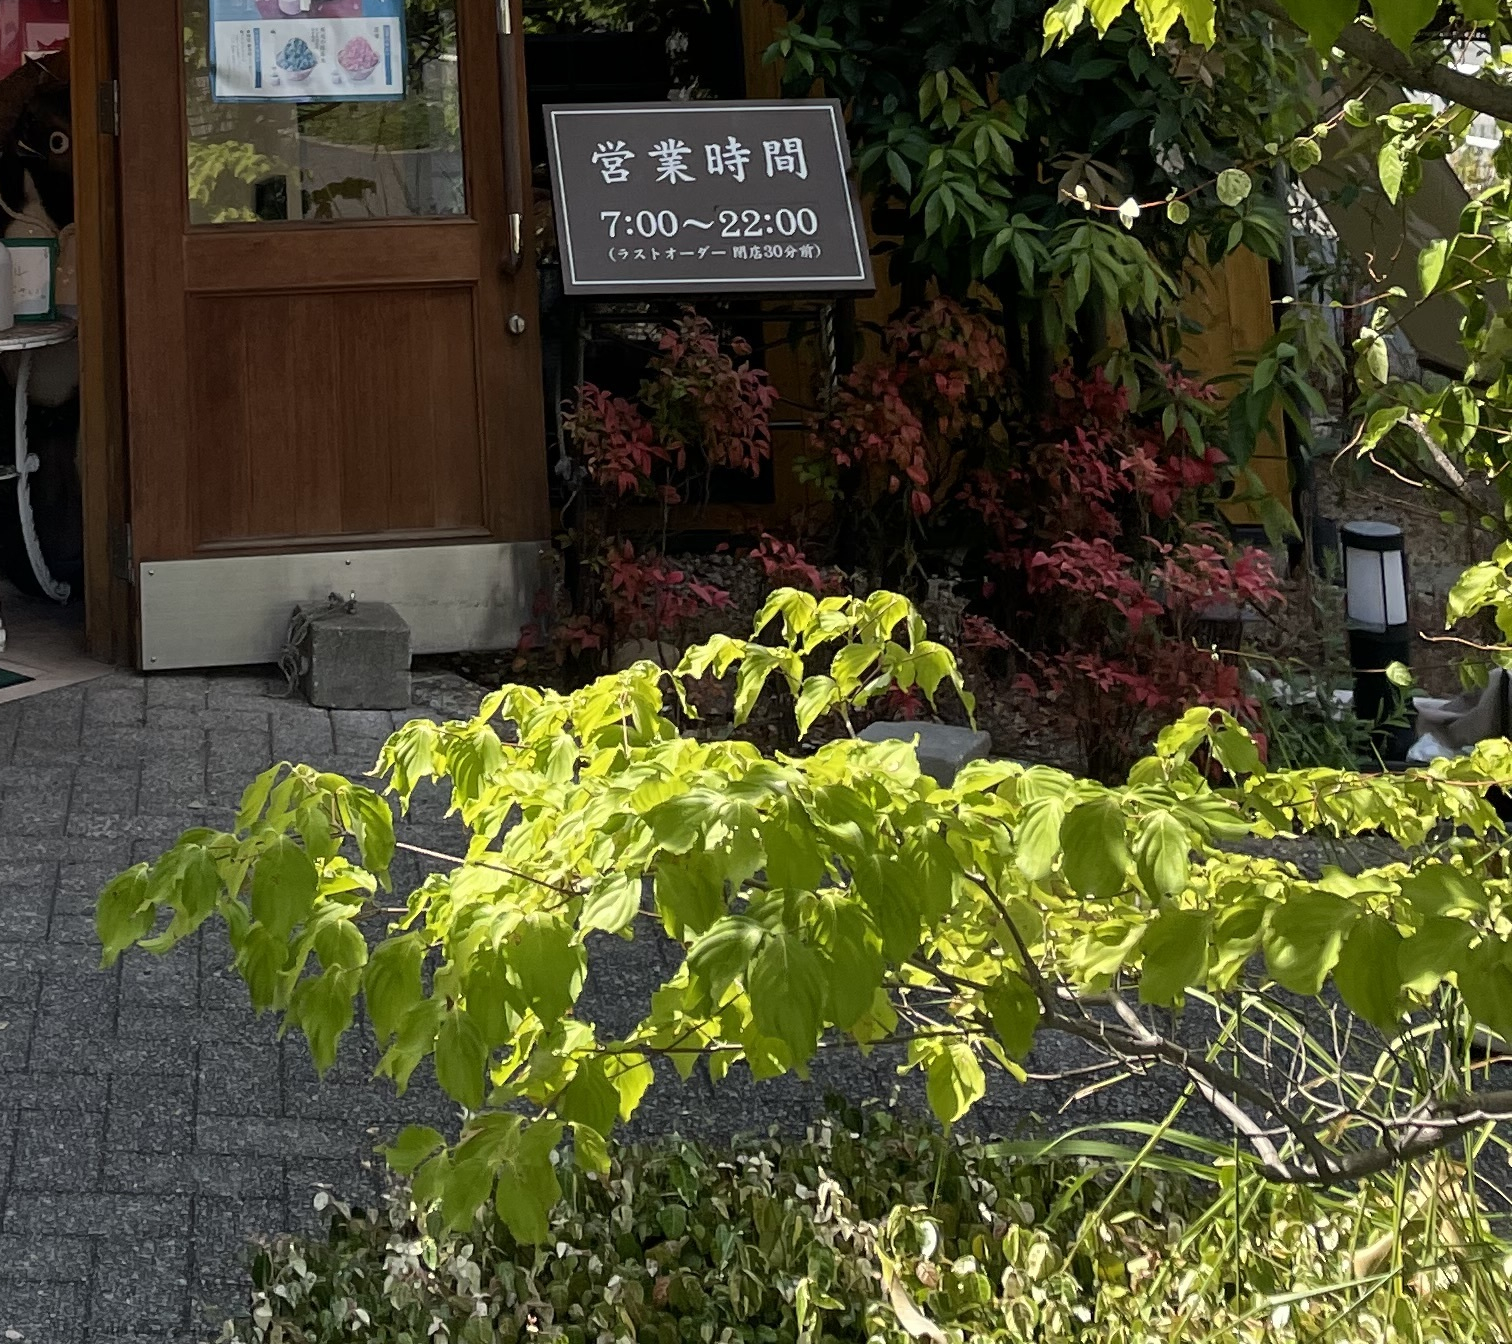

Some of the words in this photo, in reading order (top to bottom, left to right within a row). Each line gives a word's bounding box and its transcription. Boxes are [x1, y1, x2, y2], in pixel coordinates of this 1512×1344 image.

[590, 135, 809, 185] 営業時間
[599, 207, 819, 239] 7:00〜22:00
